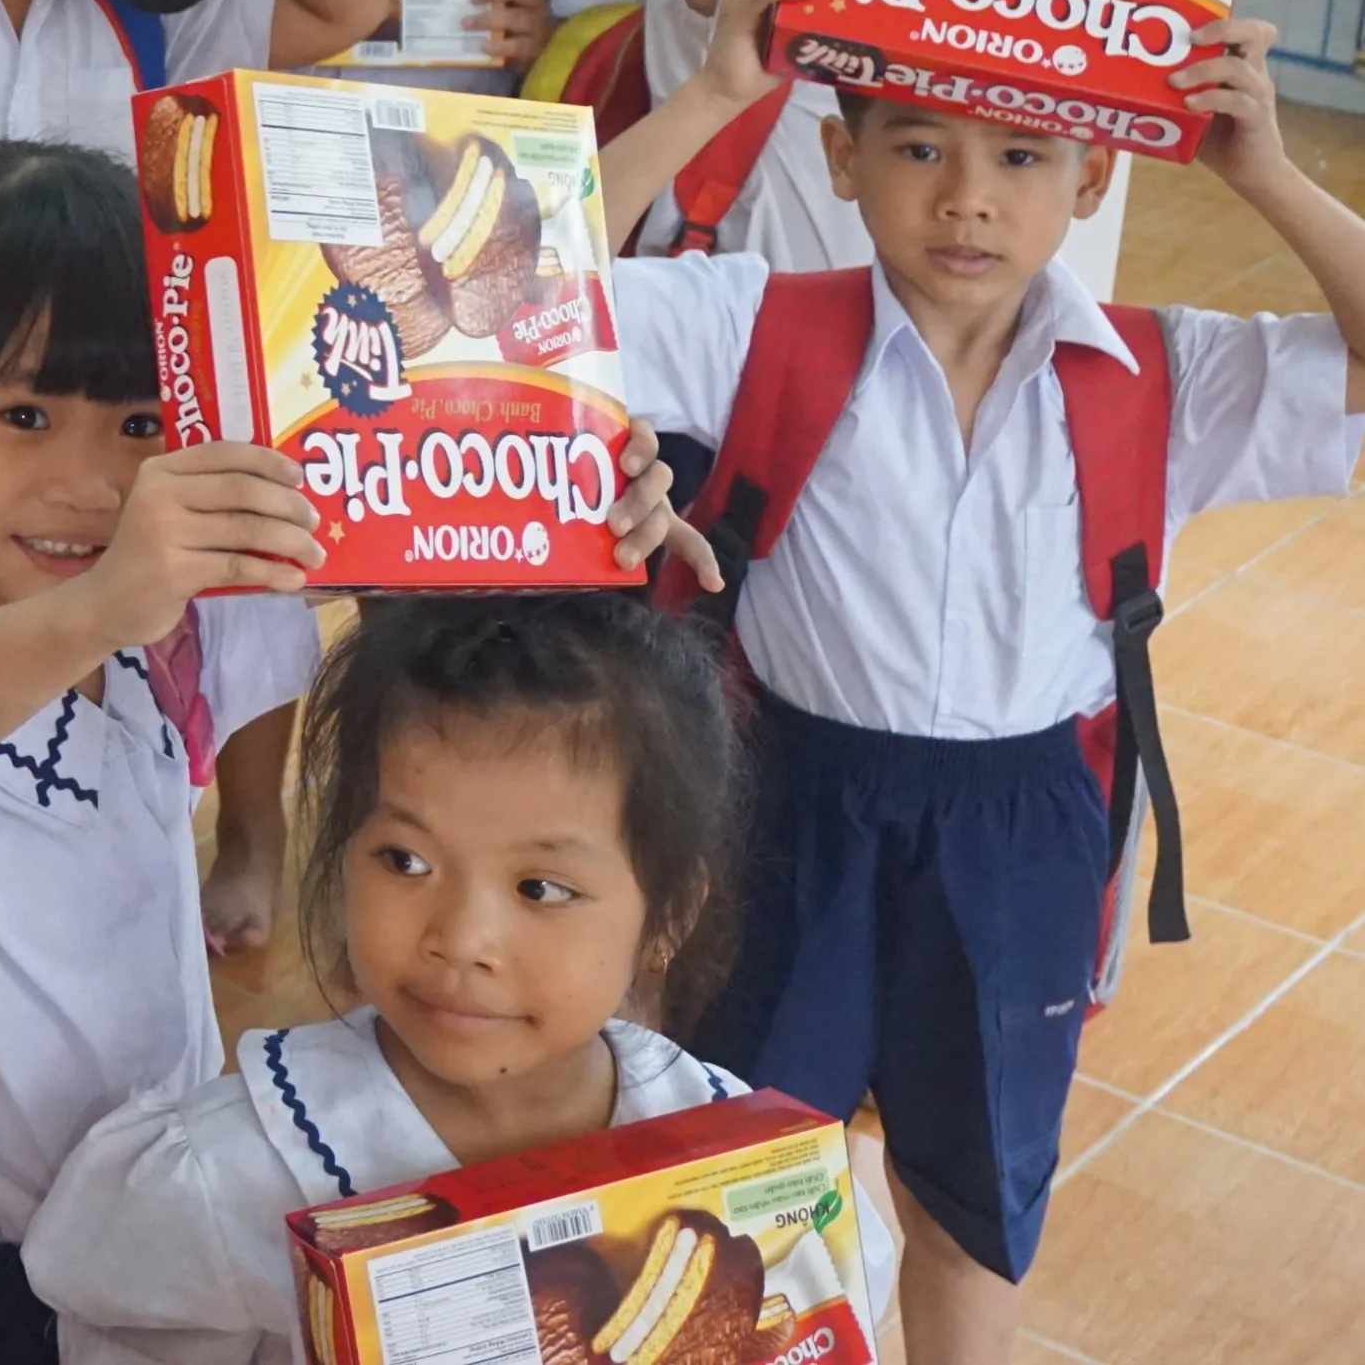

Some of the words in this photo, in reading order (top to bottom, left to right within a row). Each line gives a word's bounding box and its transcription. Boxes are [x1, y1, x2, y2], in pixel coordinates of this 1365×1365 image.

[920, 16, 1044, 65] ORION
[884, 60, 1184, 150] Choco·Pie
[975, 101, 1065, 137] ORION
[321, 306, 414, 402] Tình
[493, 402, 542, 423] Bánh
[304, 430, 616, 525] Choco·Pie
[412, 524, 518, 563] ORION
[774, 1202, 831, 1230] KHÔNG
